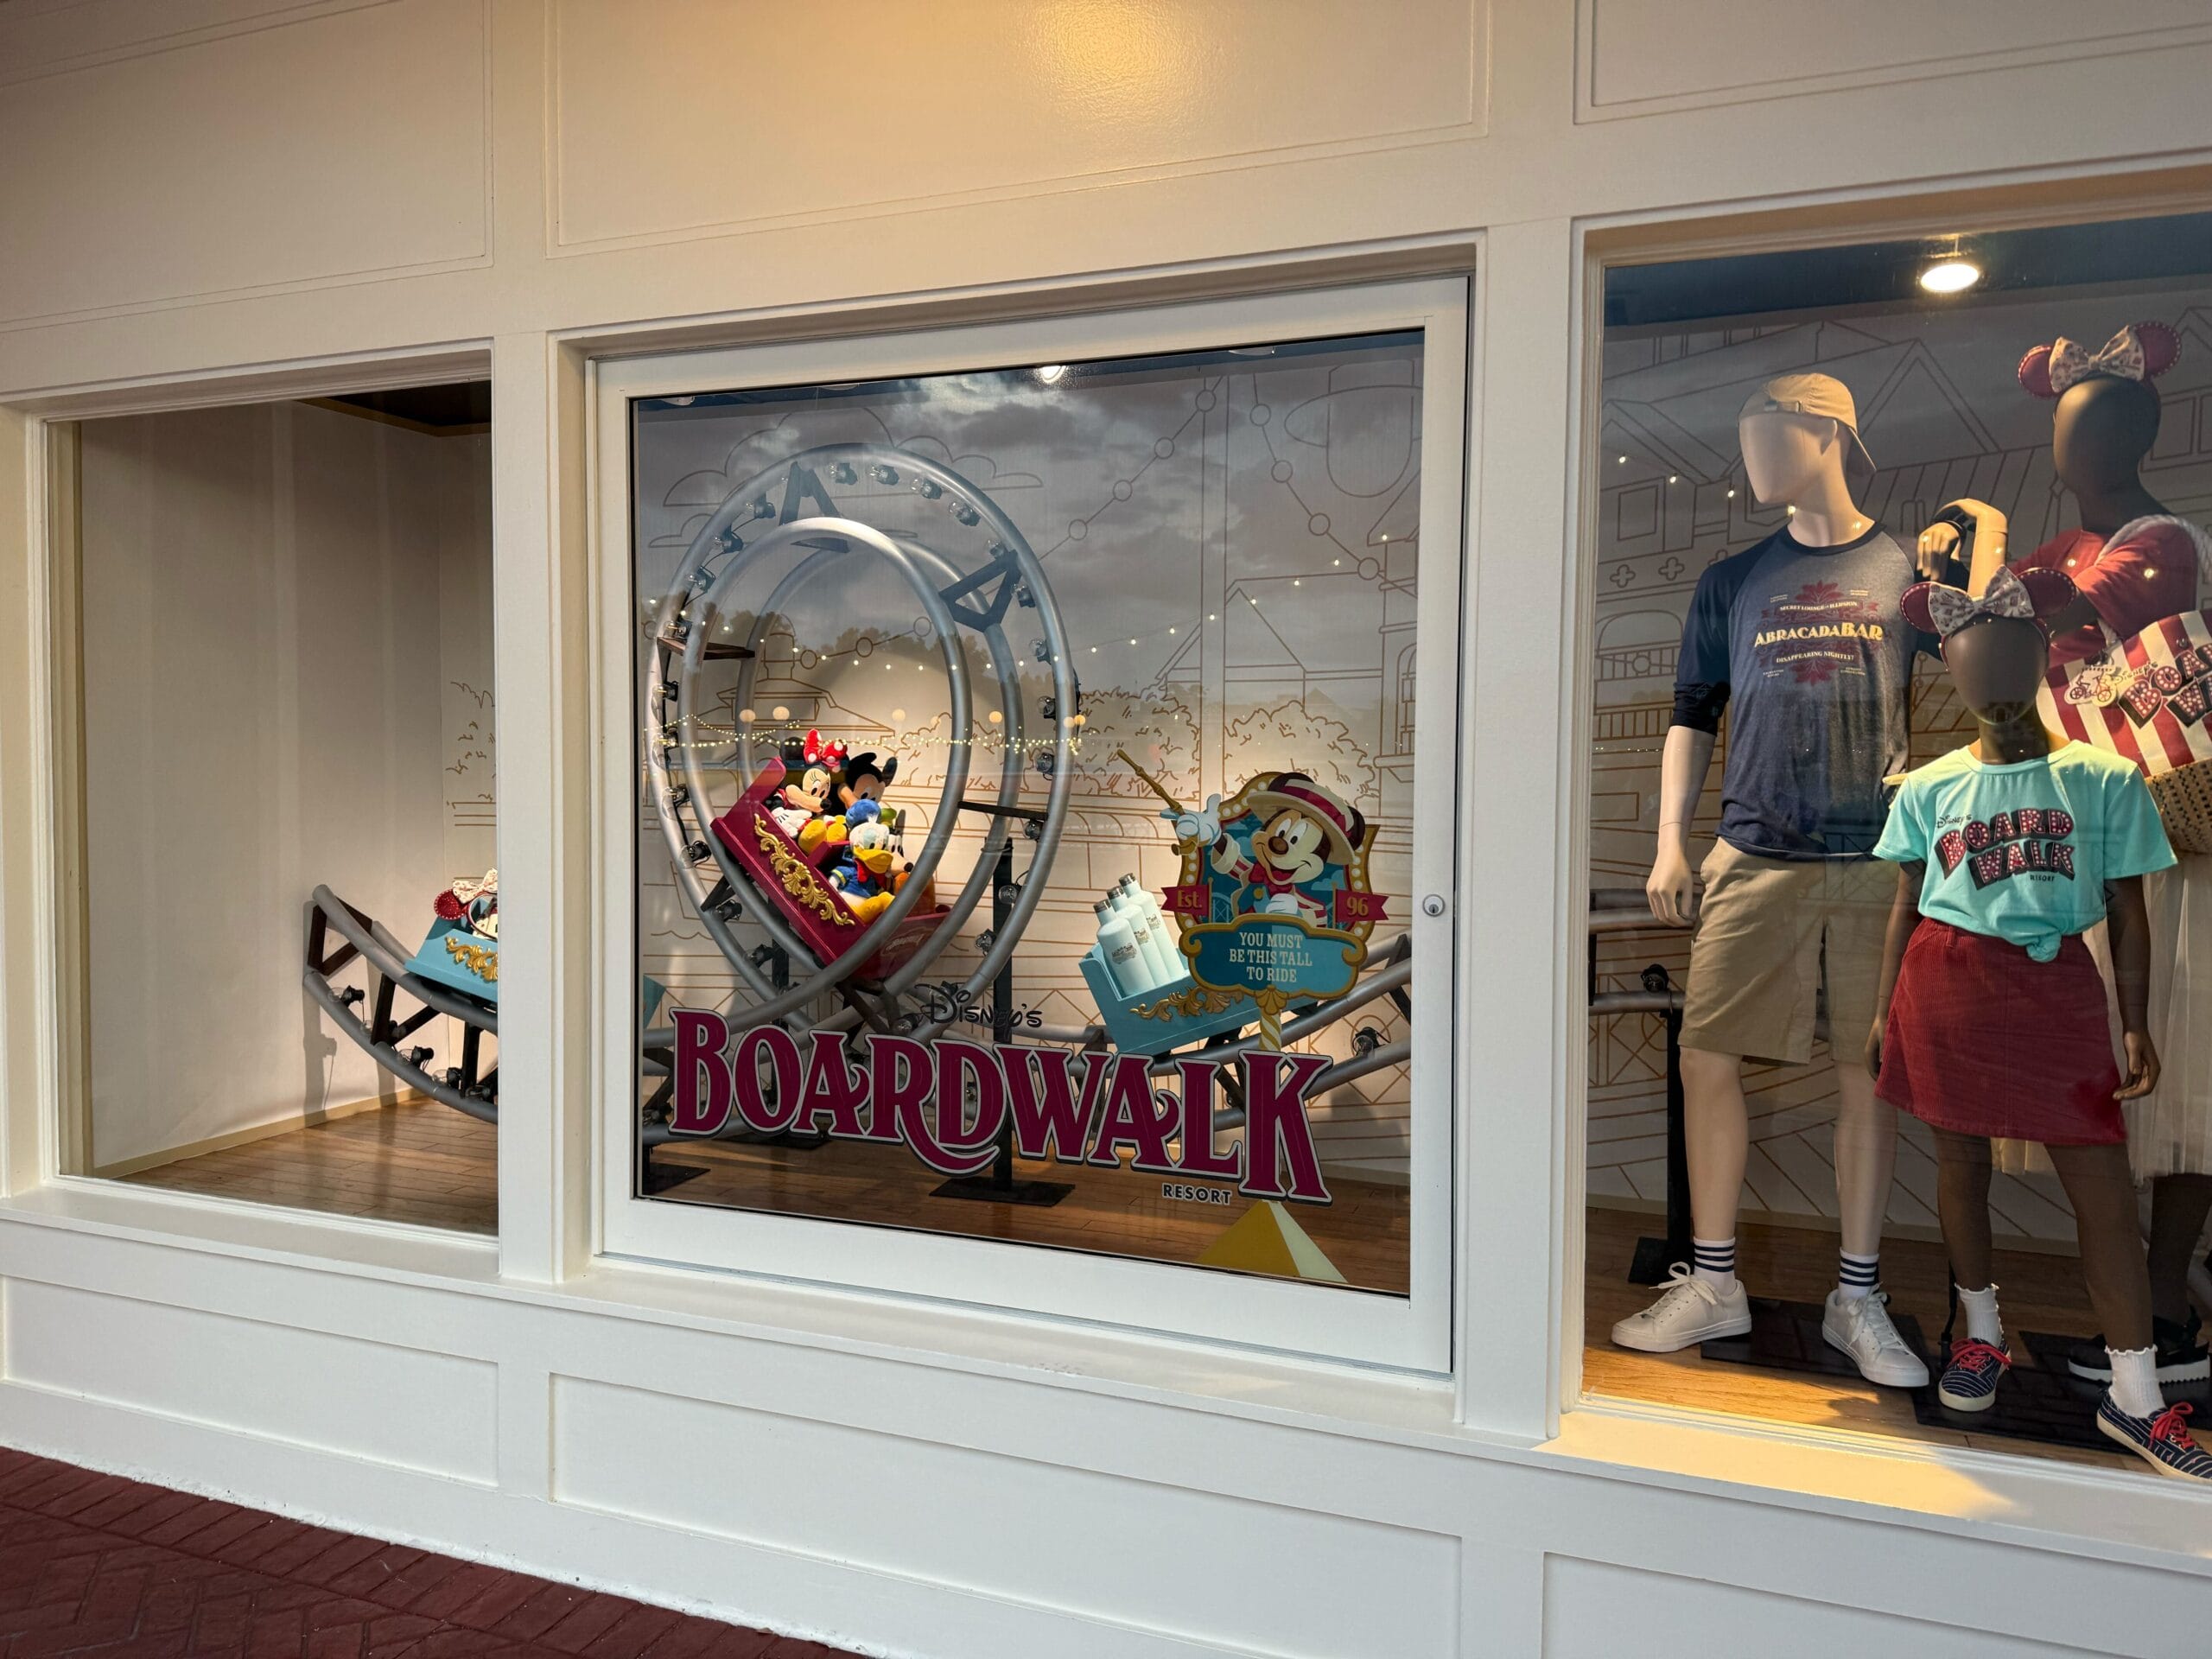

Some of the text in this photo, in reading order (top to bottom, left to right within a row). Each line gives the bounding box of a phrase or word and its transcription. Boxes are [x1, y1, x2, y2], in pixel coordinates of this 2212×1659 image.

[1754, 621, 1884, 648] ABRACADABAR
[1776, 651, 1822, 664] DISAPPEARING
[2119, 643, 2212, 729] BOA
[1934, 808, 2074, 880] BOARD
[1967, 839, 2075, 890] WALK
[1177, 890, 1203, 908] Est.
[1346, 896, 1370, 917] 96
[1239, 931, 1303, 949] YOU MUST
[1229, 948, 1313, 967] BE THIS TALL
[1246, 966, 1297, 982] TO RIDE
[669, 1007, 1332, 1205] BOARDWALK
[1161, 1183, 1233, 1205] RESORT
